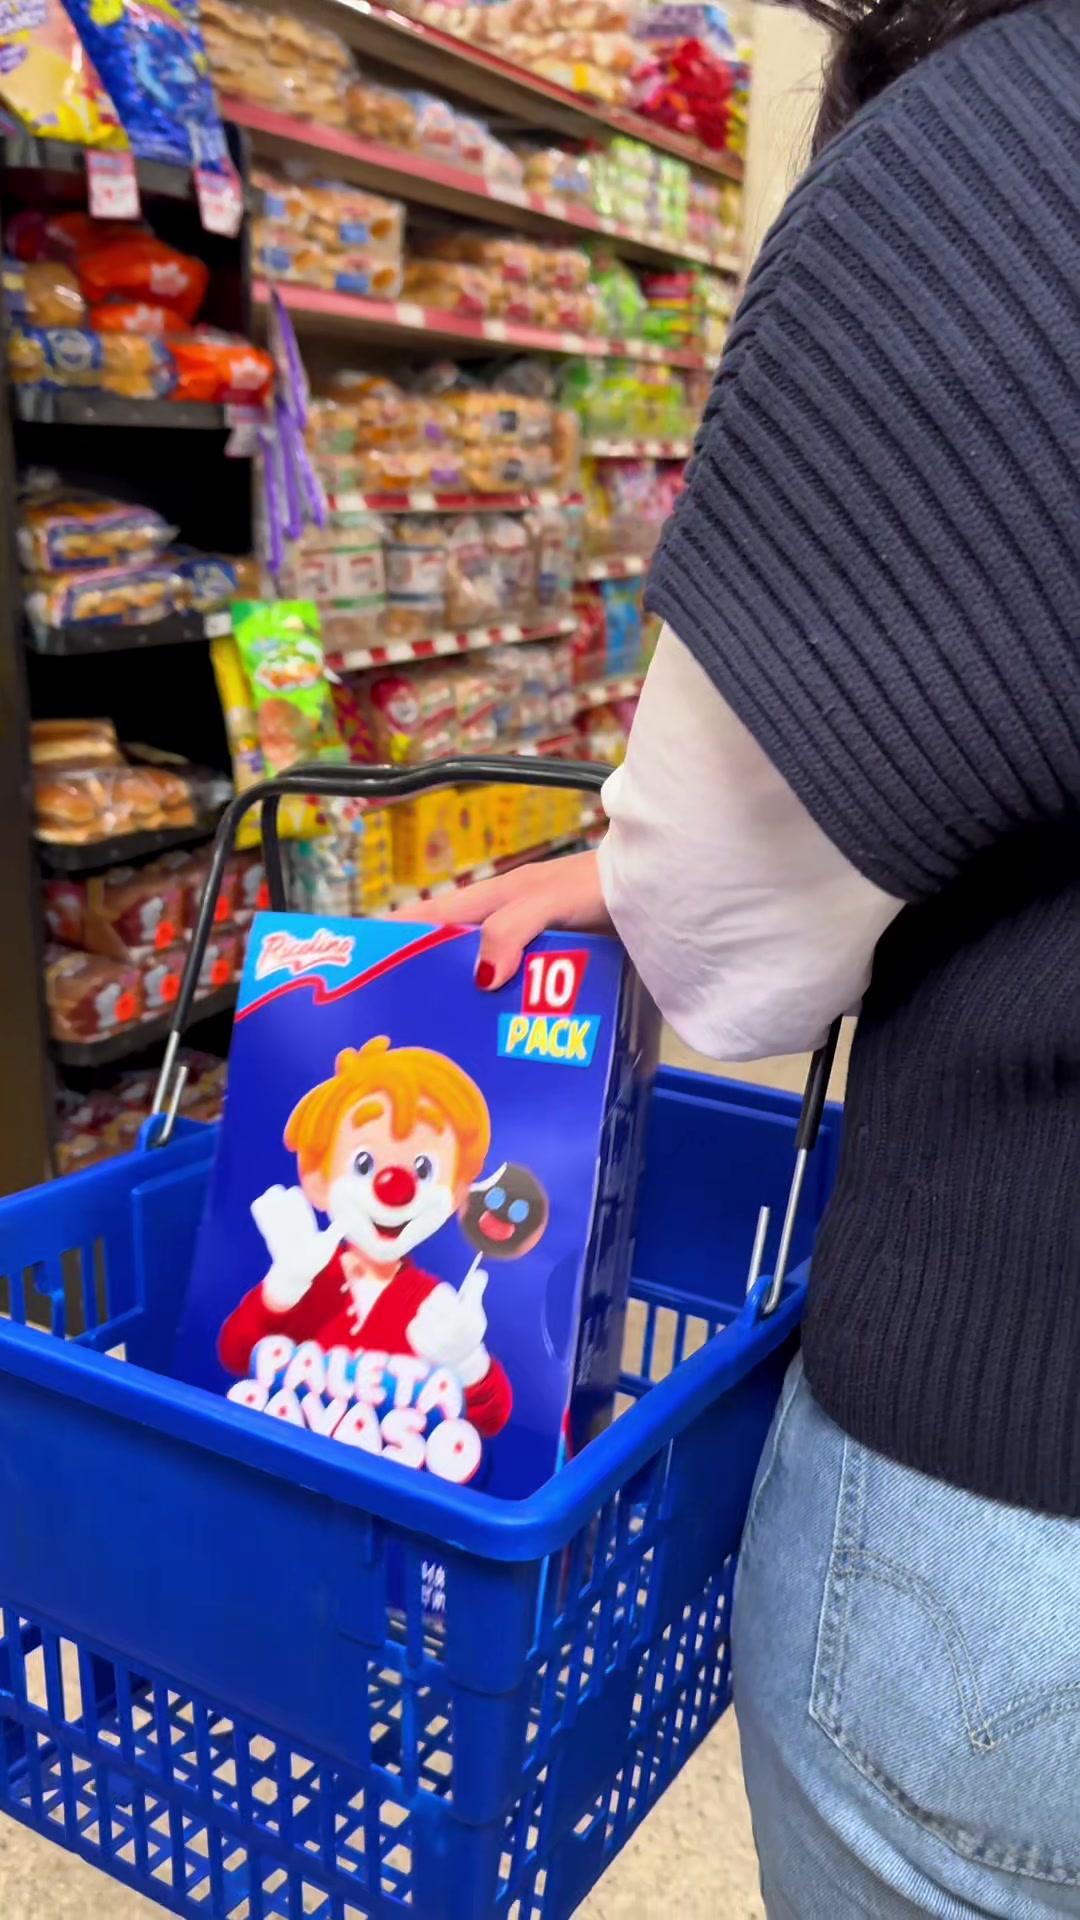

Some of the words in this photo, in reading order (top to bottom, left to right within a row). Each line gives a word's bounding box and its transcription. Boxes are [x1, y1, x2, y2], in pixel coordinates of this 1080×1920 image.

[528, 957, 576, 1008] 10
[505, 1016, 591, 1060] PACK
[252, 1335, 463, 1419] PALETA
